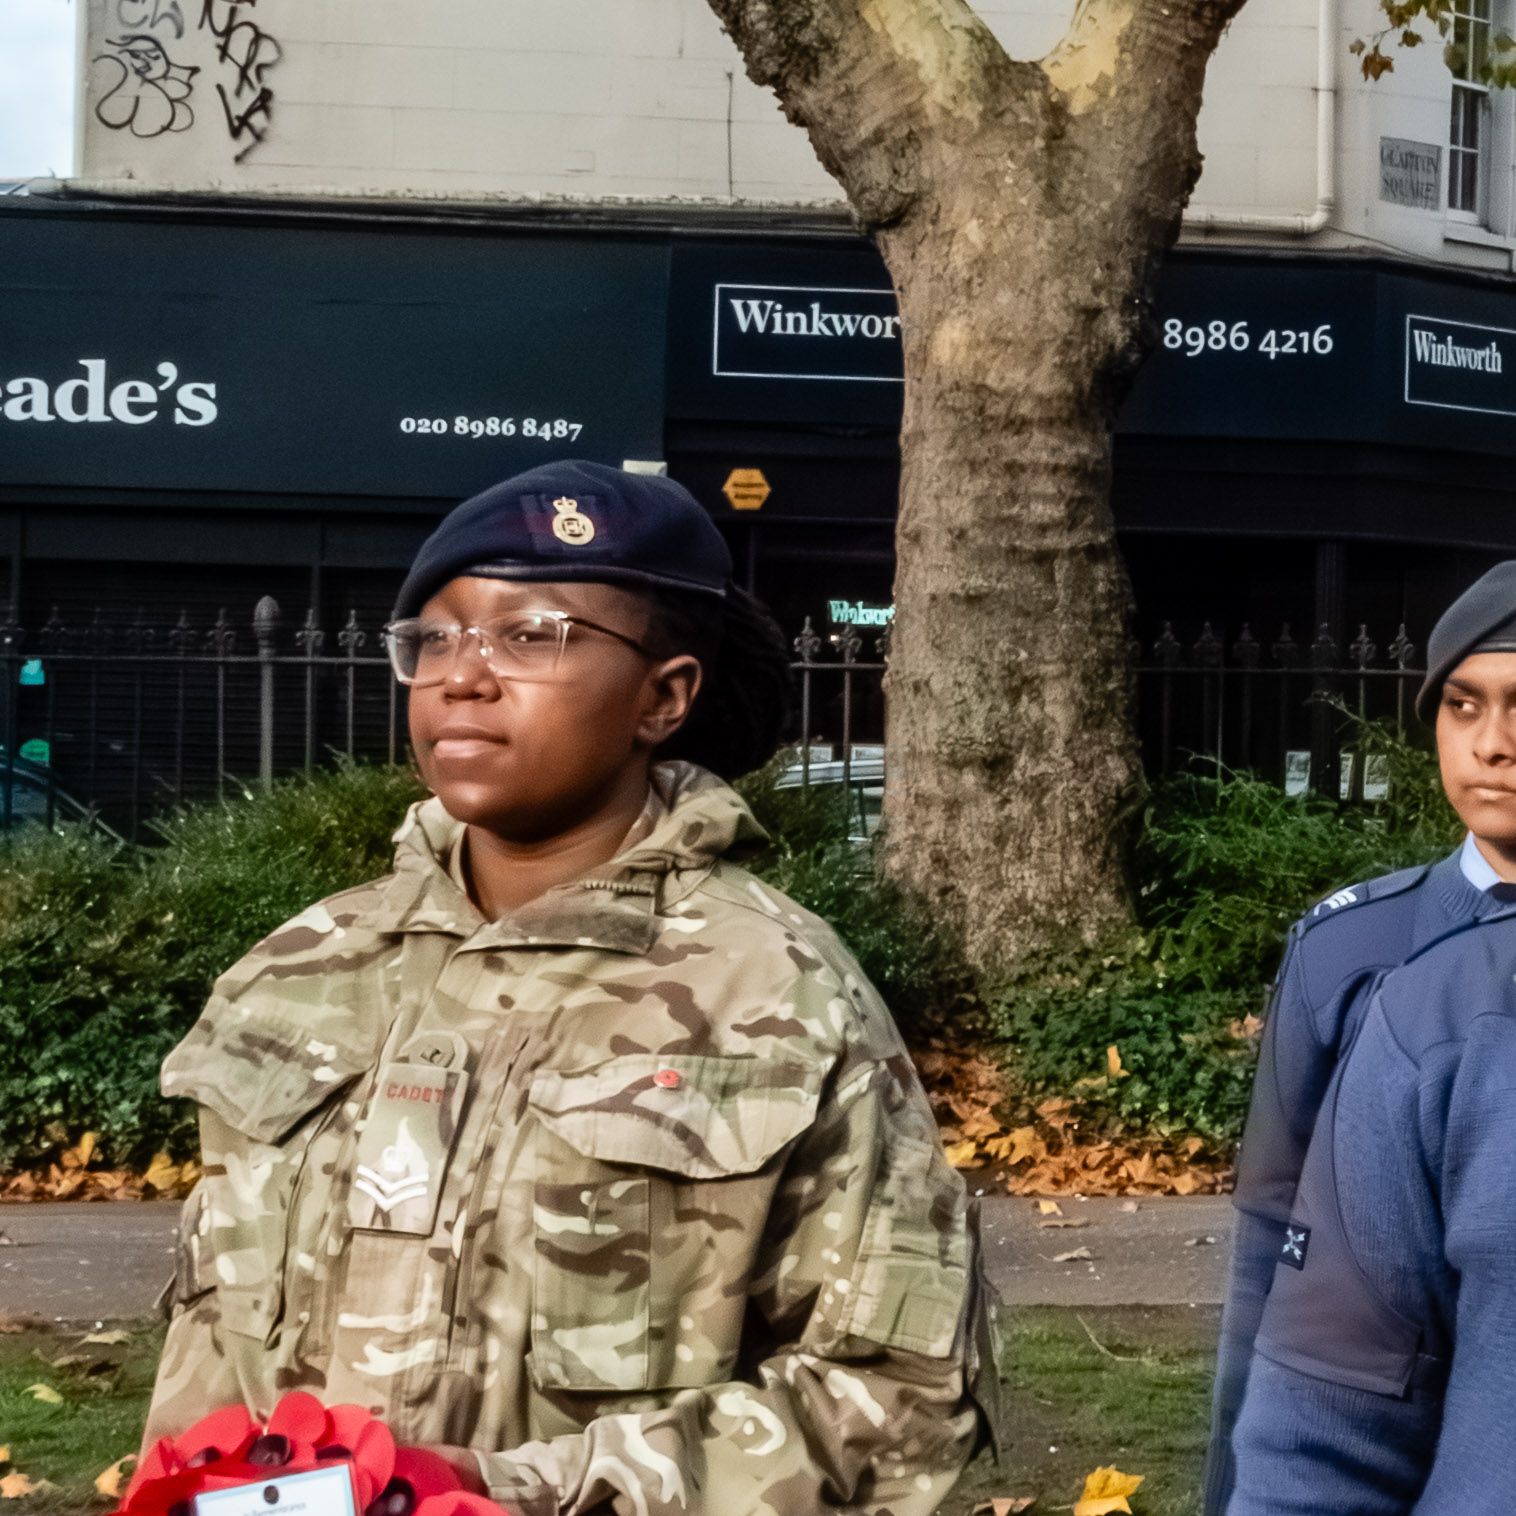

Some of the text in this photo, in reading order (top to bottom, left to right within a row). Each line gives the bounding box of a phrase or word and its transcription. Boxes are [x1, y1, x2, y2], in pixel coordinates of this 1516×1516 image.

[729, 298, 901, 338] Winkwor
[1163, 318, 1334, 360] 8986 4216
[1413, 329, 1503, 374] Winkworth
[0, 358, 218, 426] ade’s
[400, 415, 583, 442] 020 8986 8487
